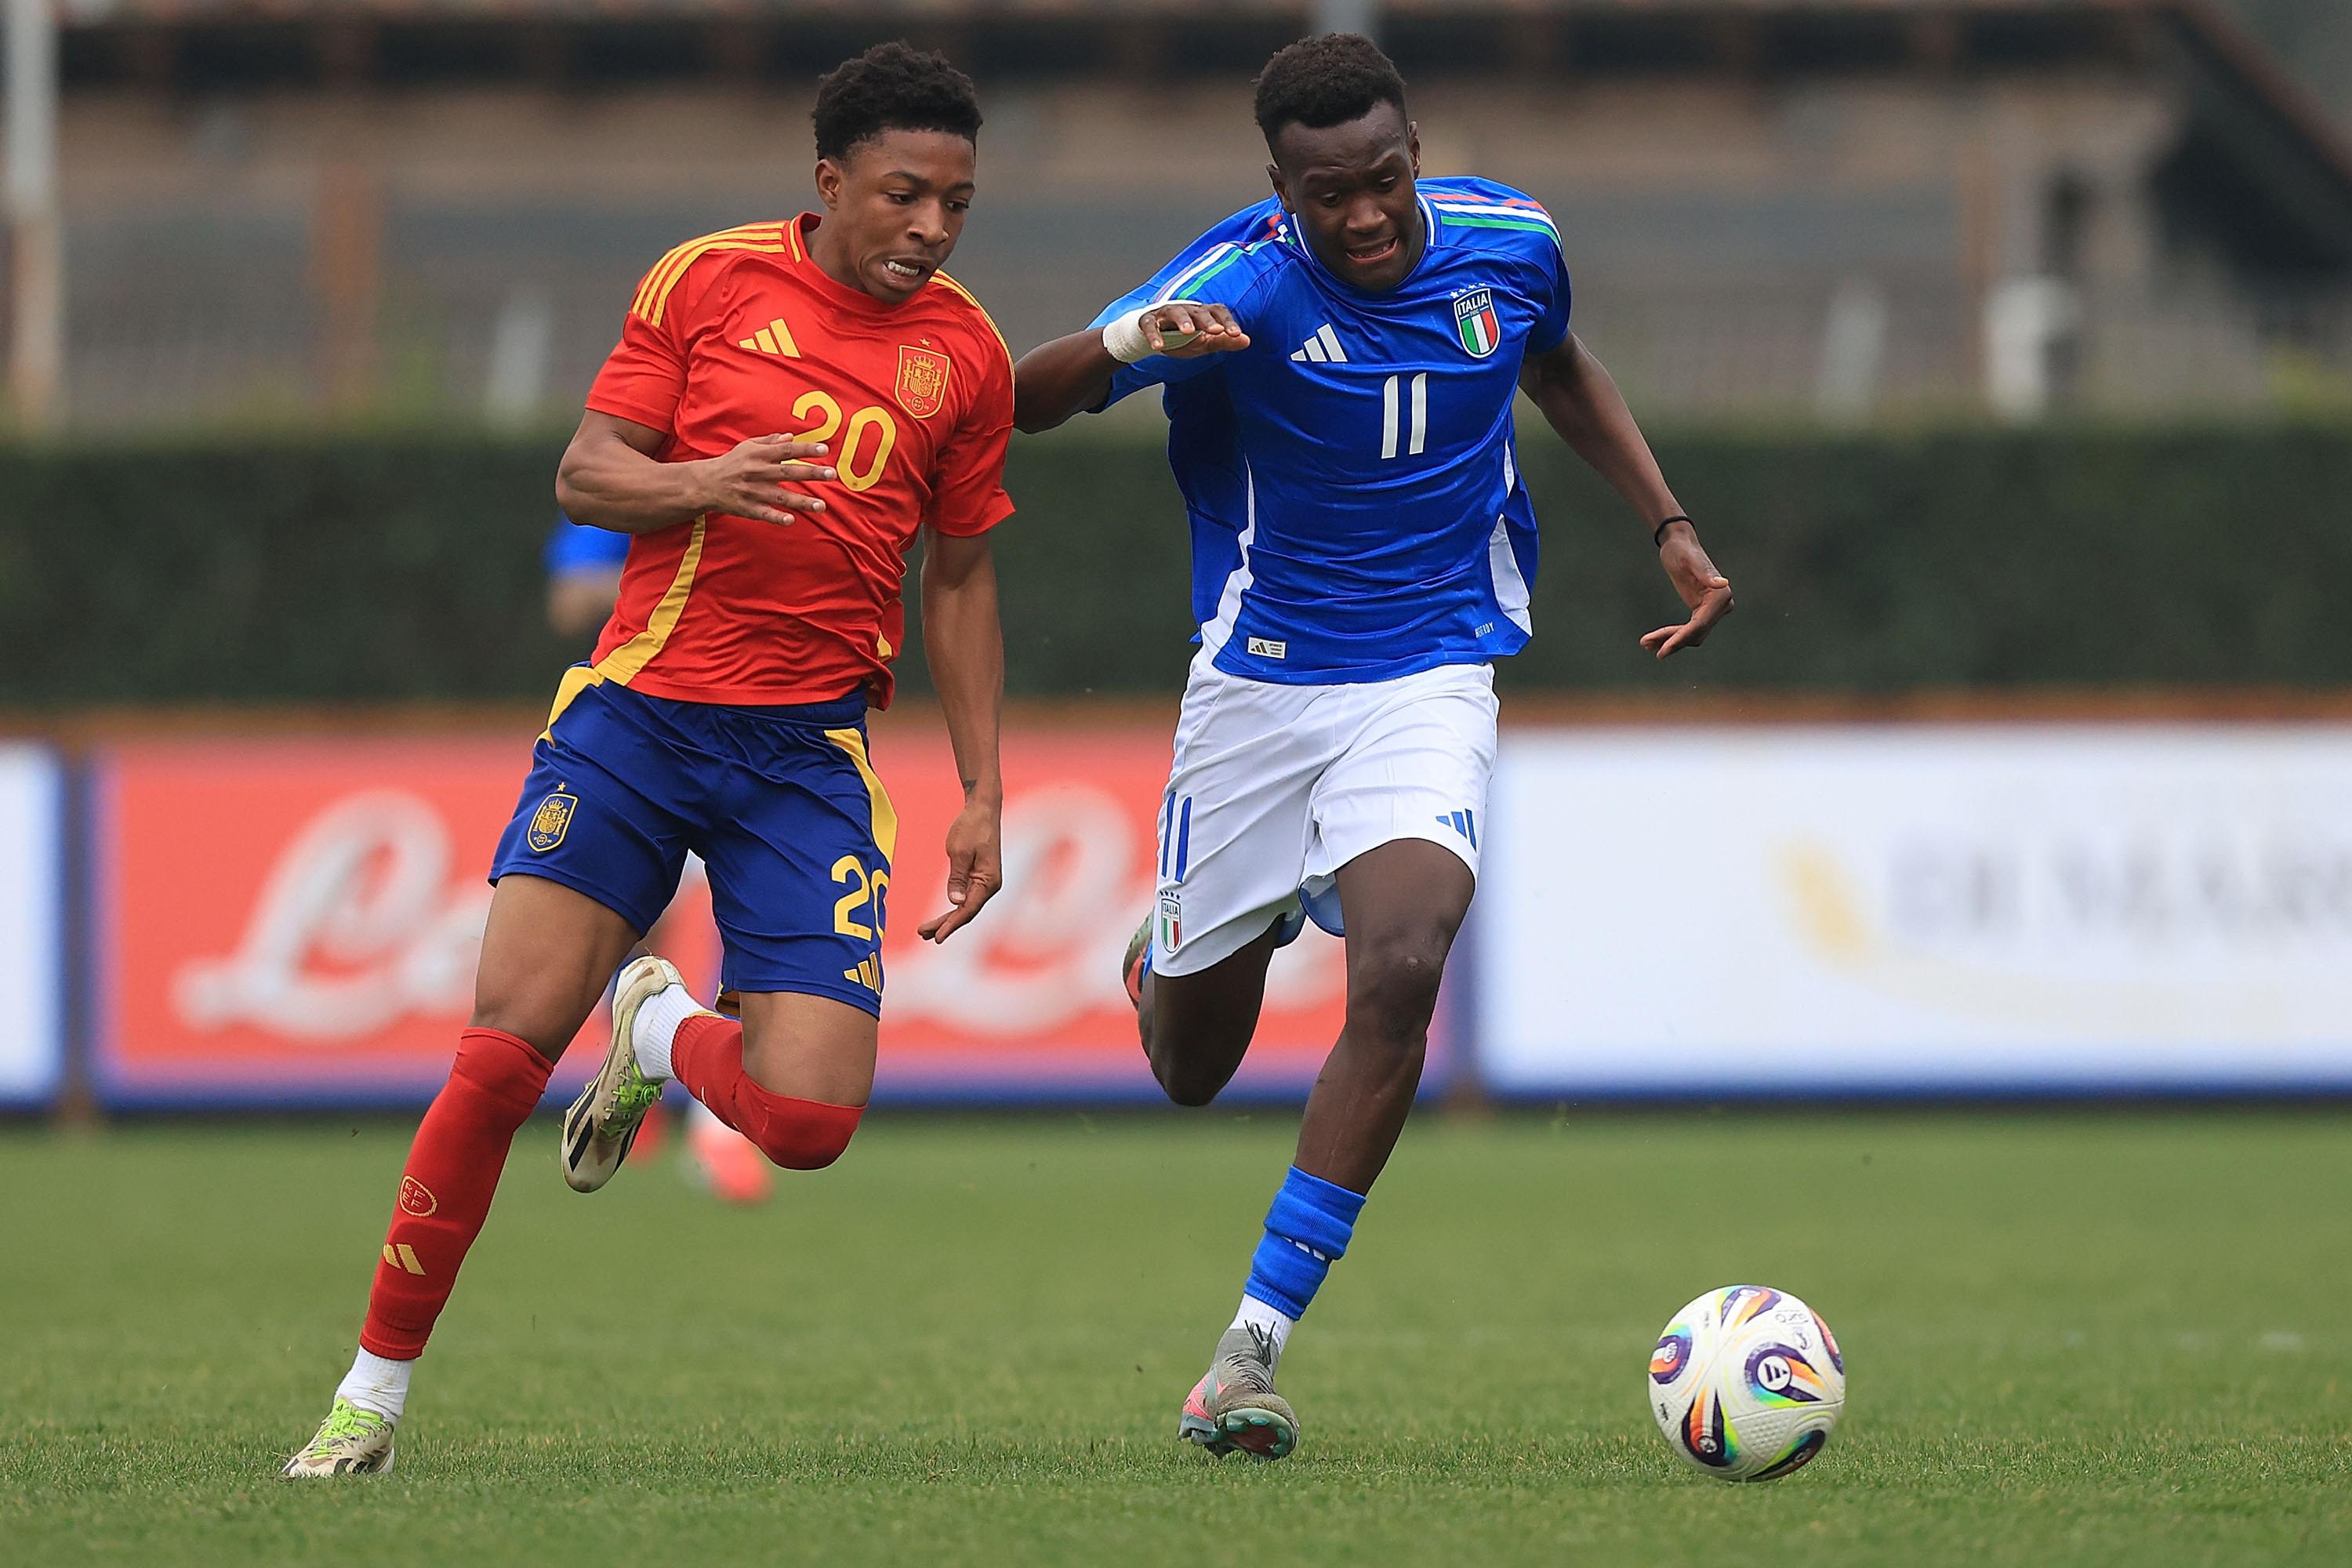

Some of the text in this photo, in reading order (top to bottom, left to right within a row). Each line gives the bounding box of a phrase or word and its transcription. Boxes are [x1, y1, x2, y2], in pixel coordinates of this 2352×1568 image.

[1457, 293, 1489, 316] ITALIA
[781, 390, 897, 492] 20
[1381, 372, 1427, 459] 11
[1161, 791, 1192, 884] 11
